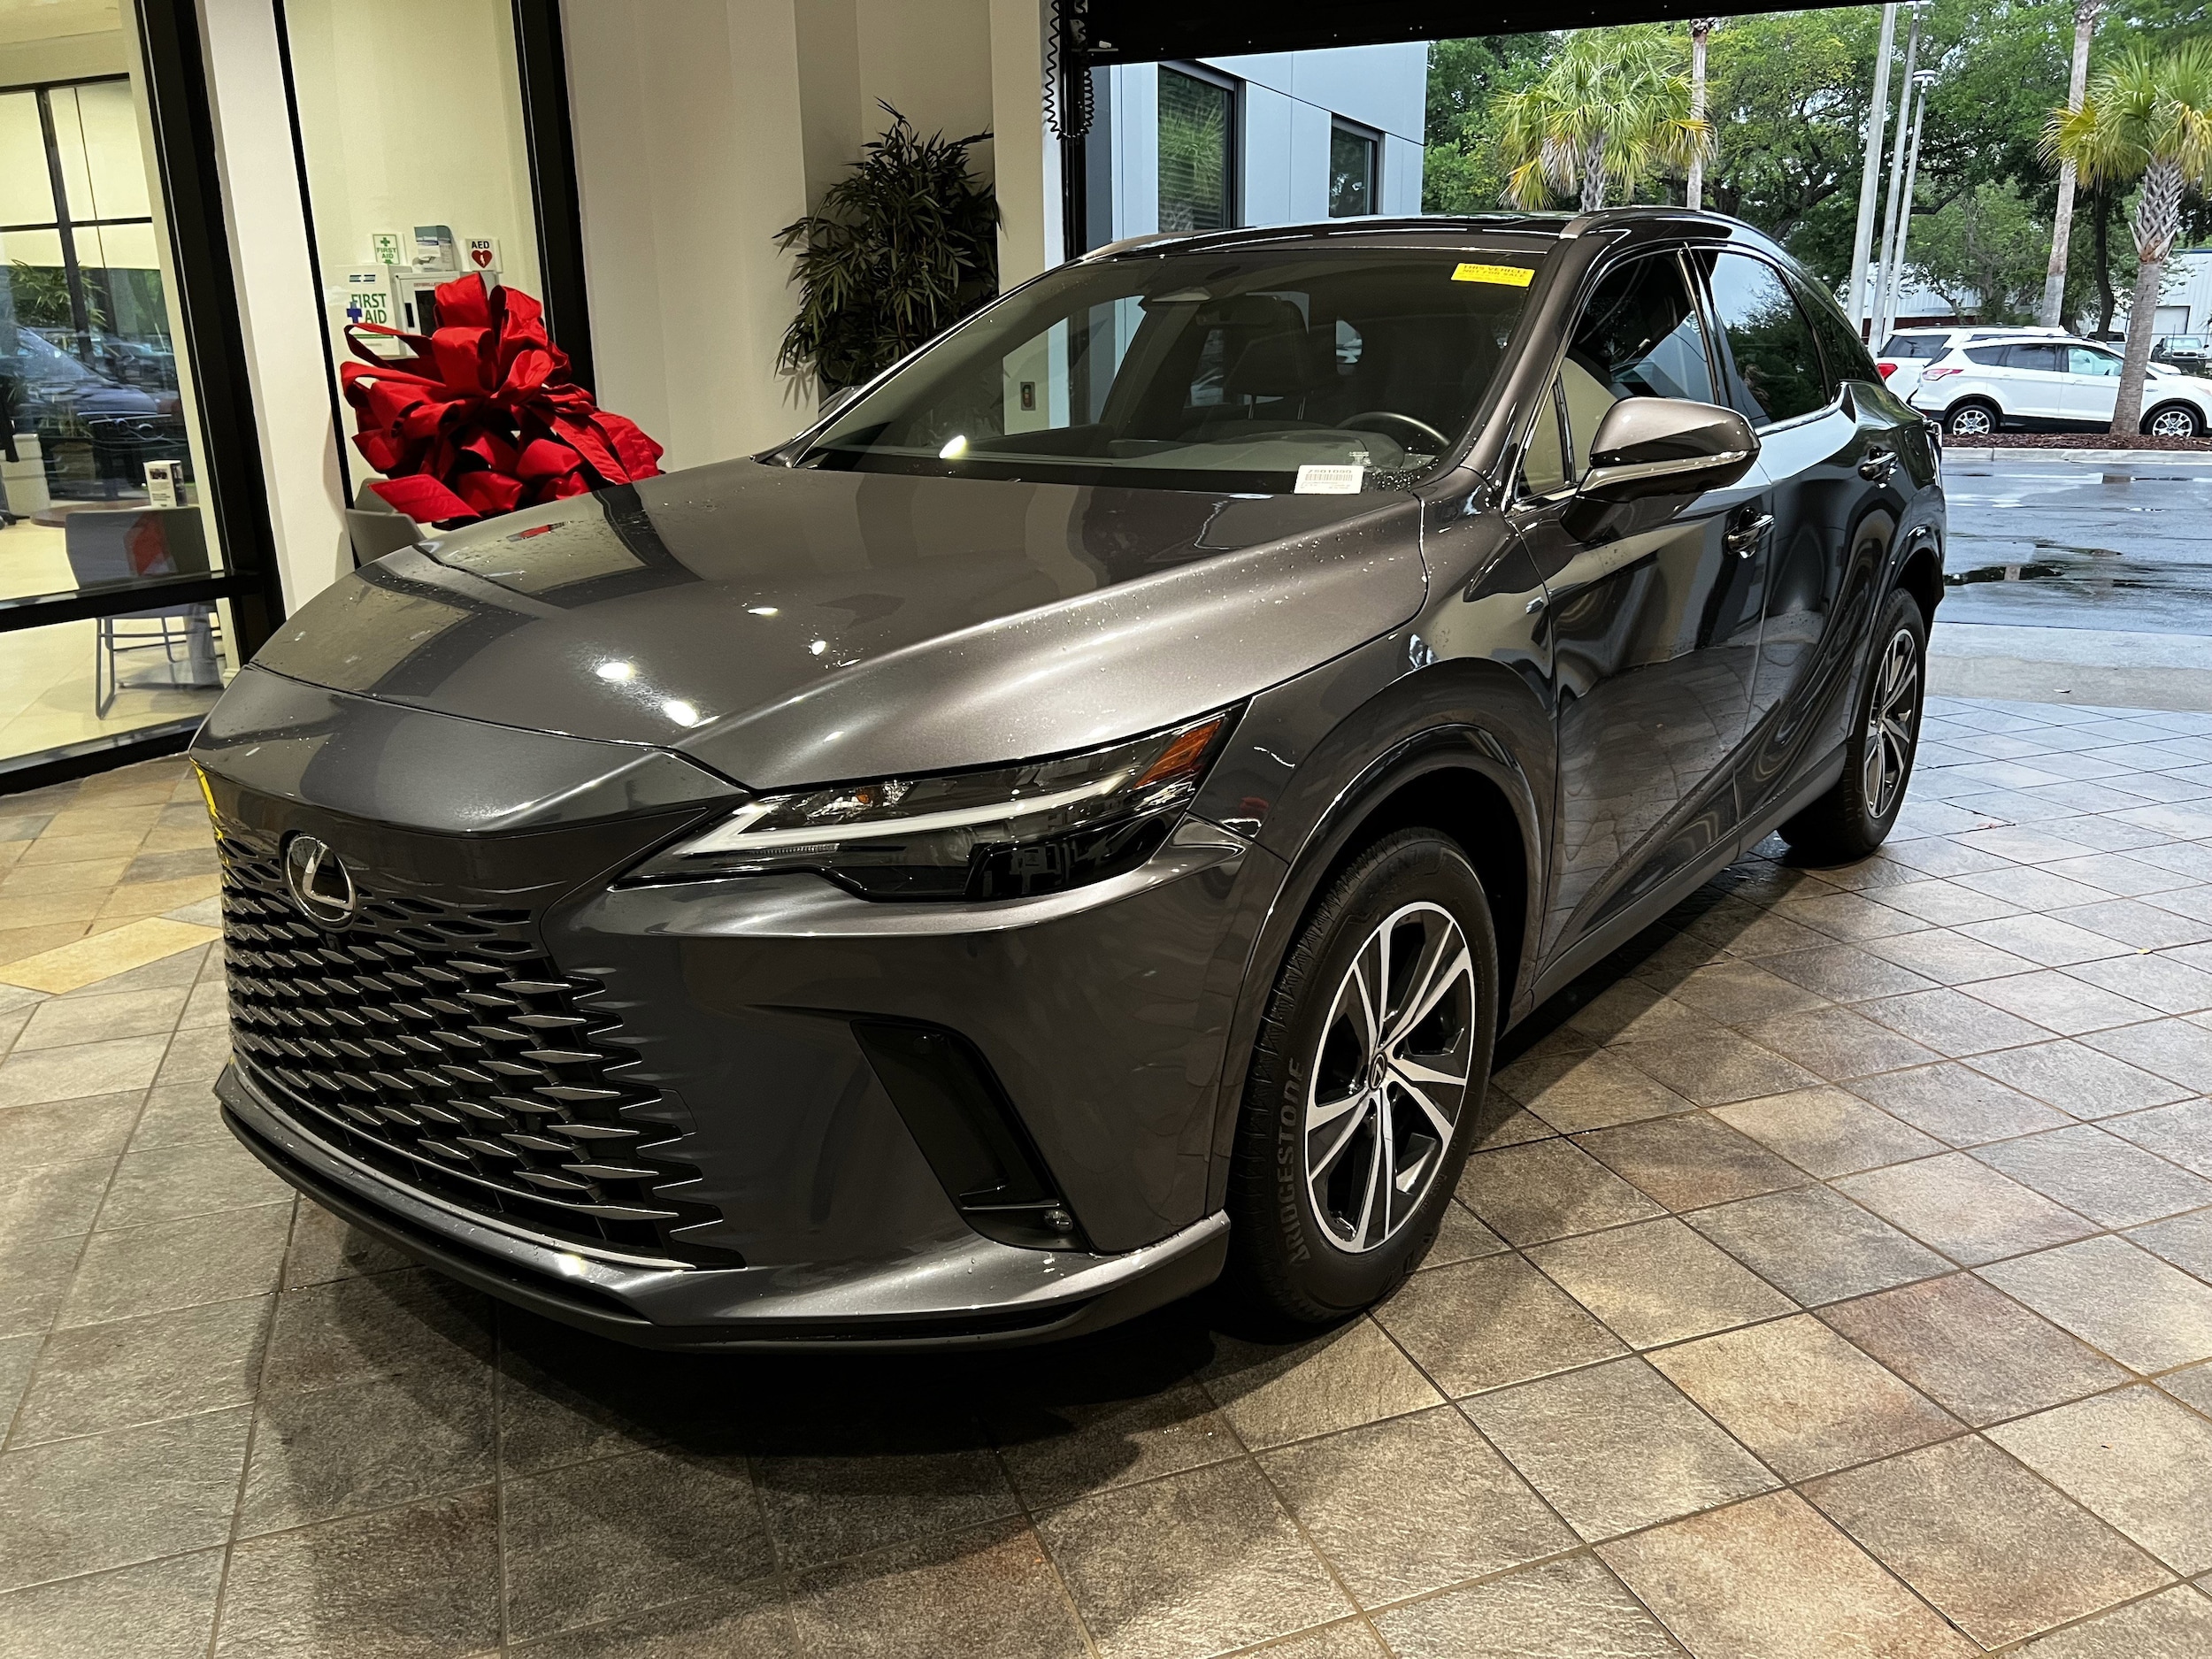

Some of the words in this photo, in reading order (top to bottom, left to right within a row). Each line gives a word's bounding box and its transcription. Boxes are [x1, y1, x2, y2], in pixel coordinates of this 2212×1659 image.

[471, 241, 489, 250] AED
[351, 293, 387, 308] FIRST
[365, 309, 388, 324] AID
[1277, 1057, 1311, 1268] BRIDGESTONE
